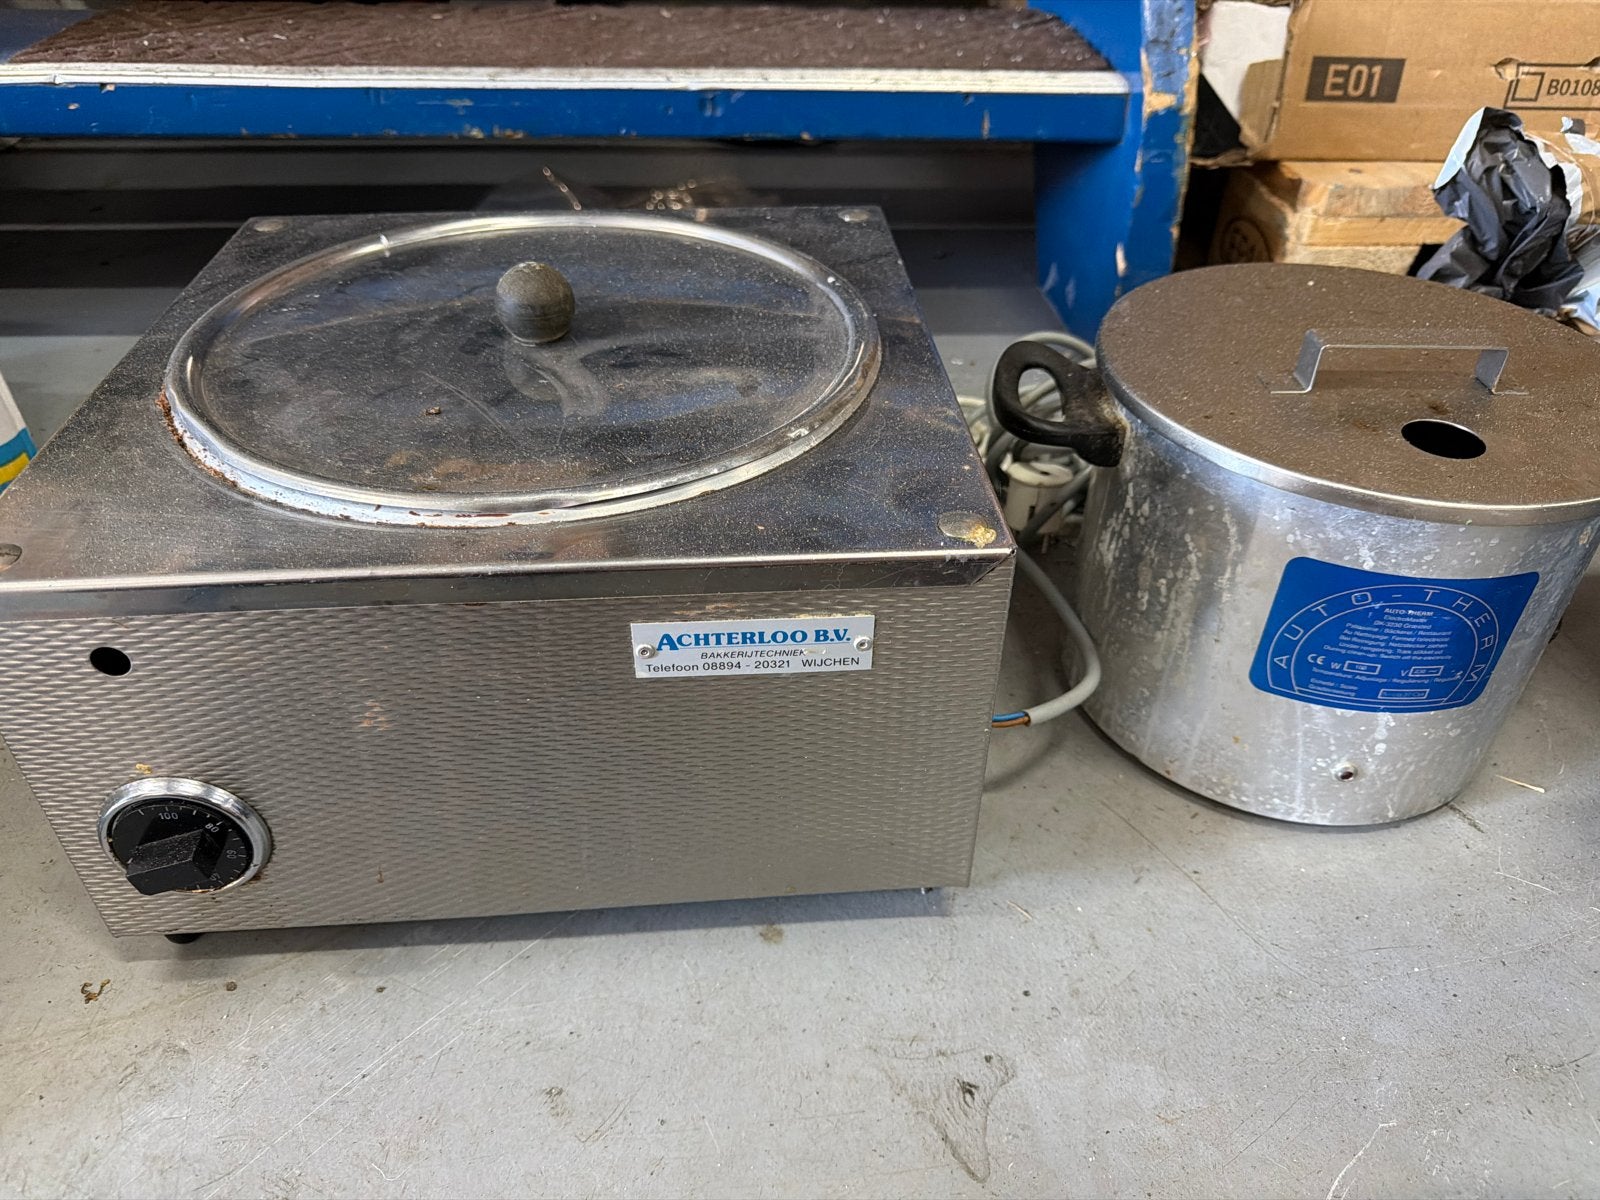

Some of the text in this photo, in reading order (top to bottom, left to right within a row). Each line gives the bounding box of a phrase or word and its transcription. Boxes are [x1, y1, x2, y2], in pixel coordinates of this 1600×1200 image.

[1323, 63, 1384, 98] E01
[1546, 78, 1600, 97] B0108
[656, 628, 851, 651] ACHTERLOO B.V.
[700, 649, 807, 660] BAKKERIJTECHNIEK
[645, 663, 699, 673] Telefoon
[703, 661, 742, 671] 08894
[754, 660, 791, 669] 20321
[801, 657, 861, 668] WIJCHEN
[1330, 661, 1342, 670] W
[1400, 669, 1409, 677] V
[158, 811, 179, 820] 100
[205, 823, 220, 833] 80
